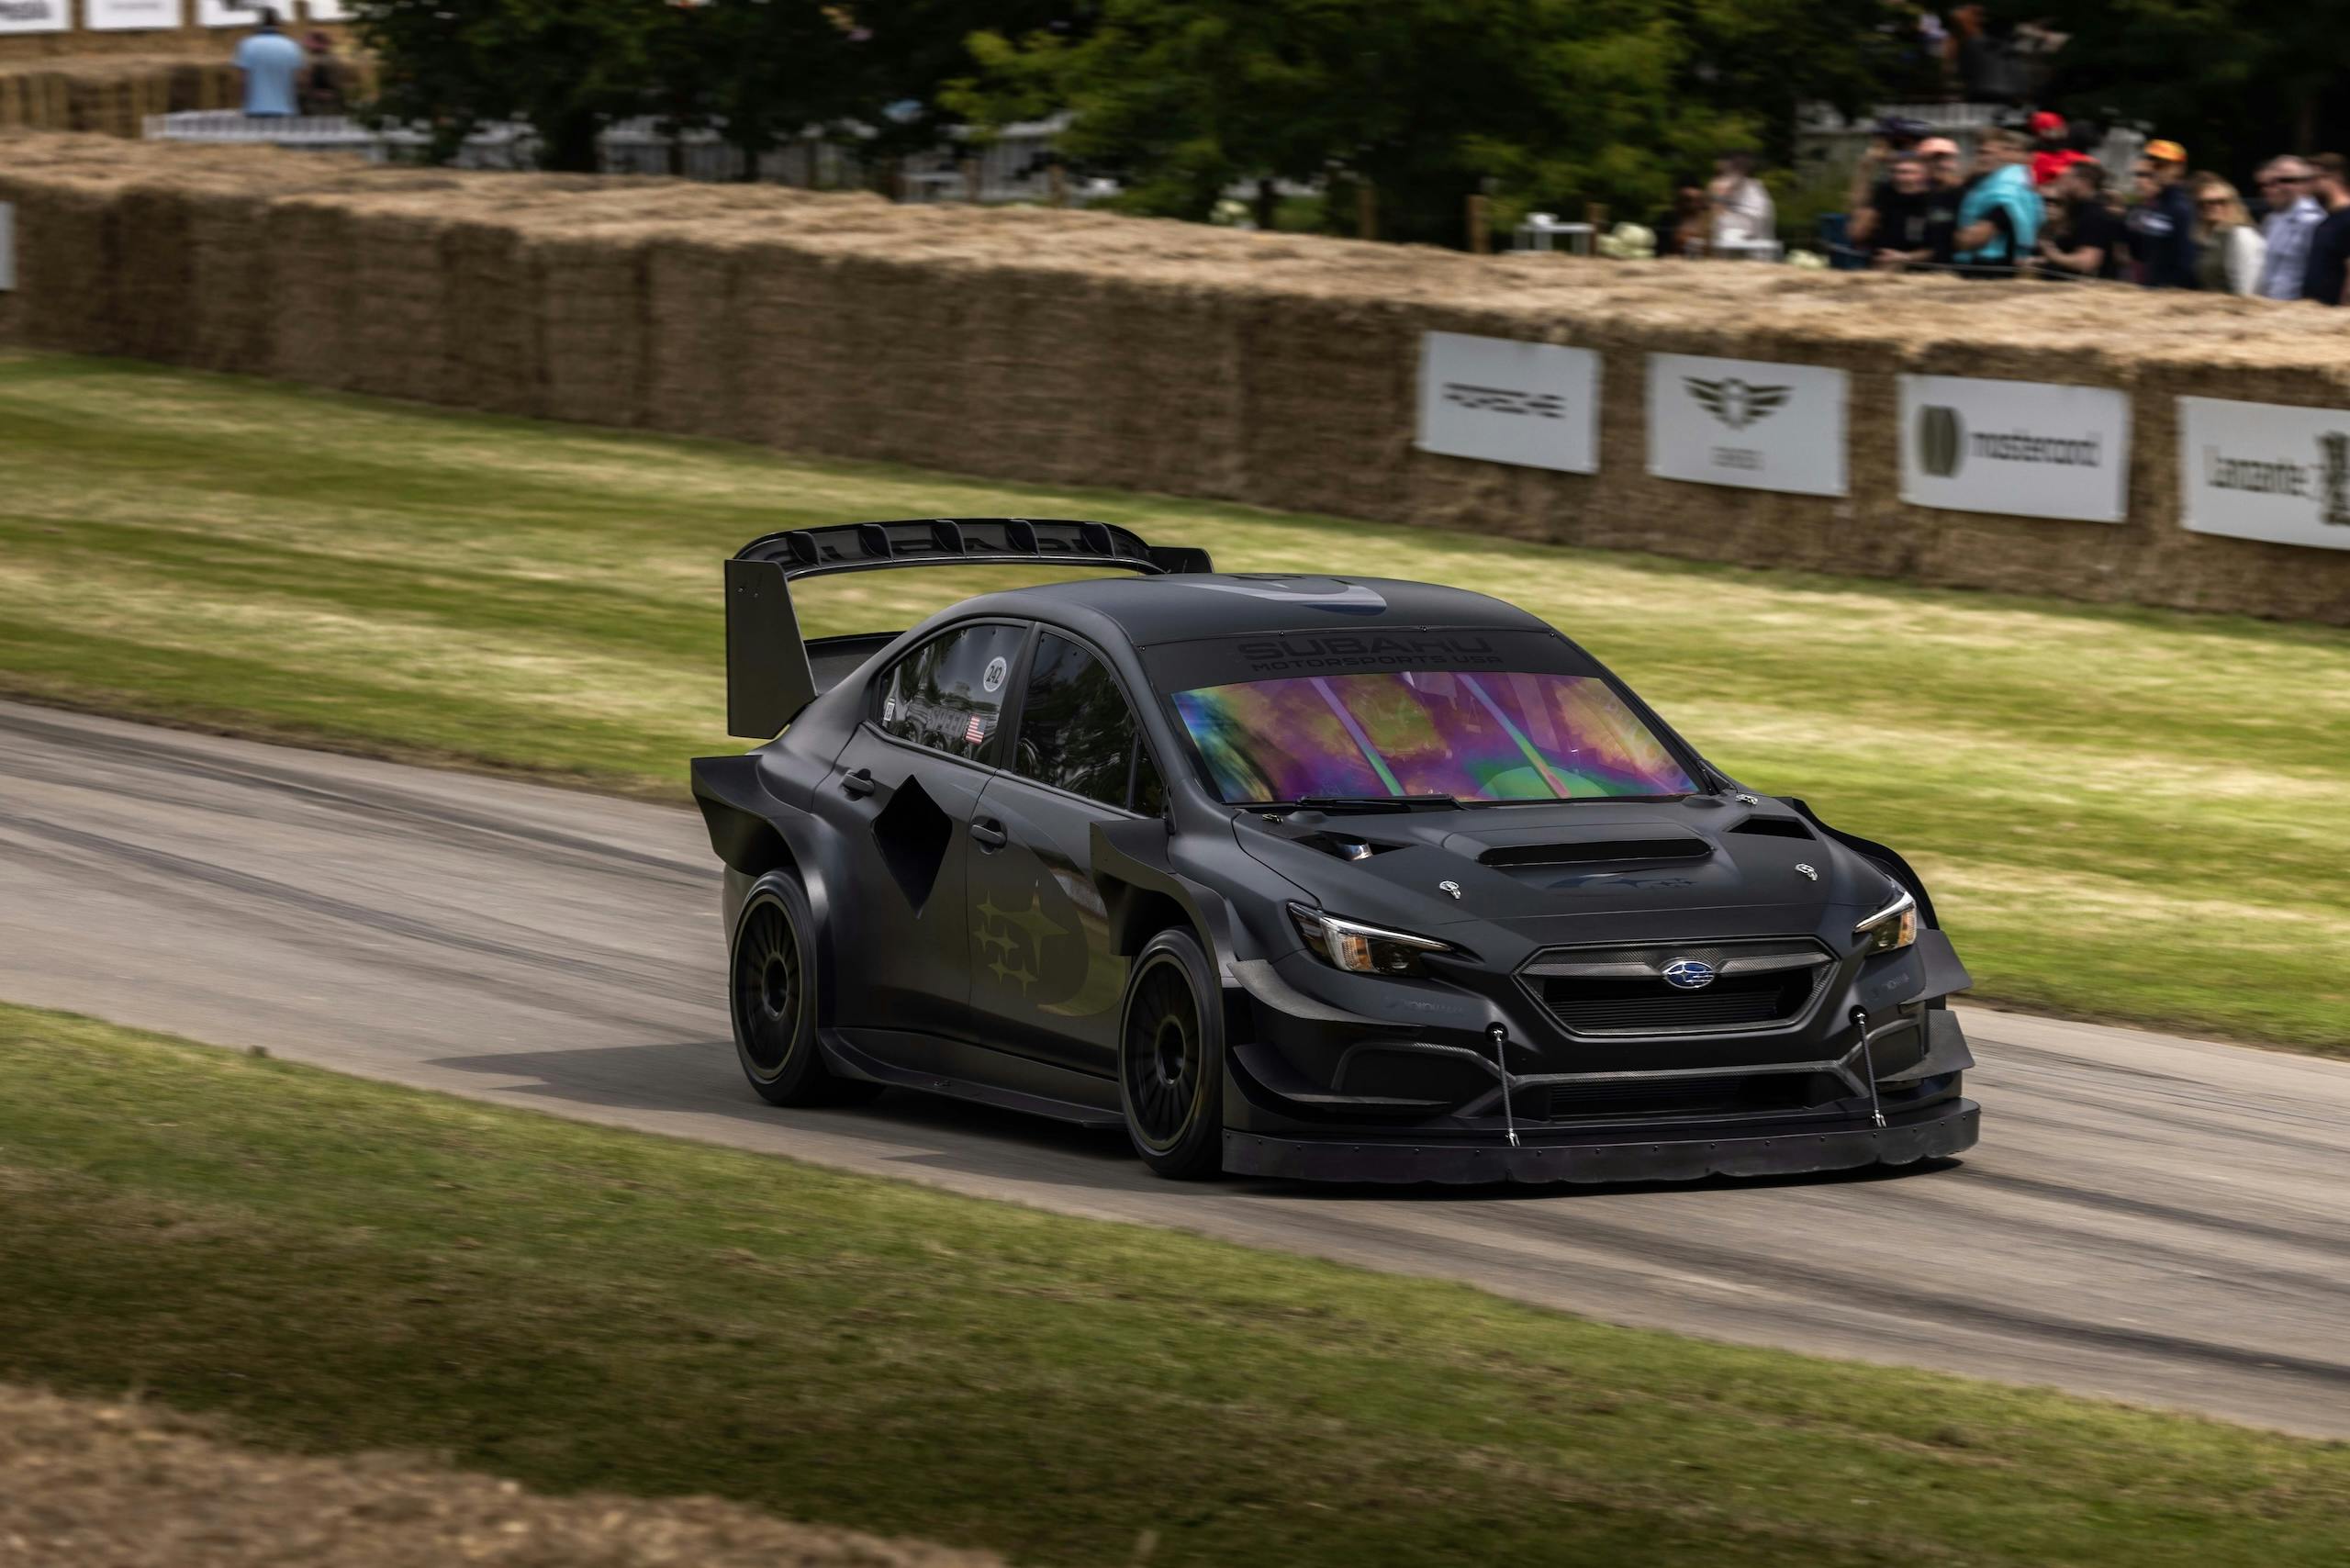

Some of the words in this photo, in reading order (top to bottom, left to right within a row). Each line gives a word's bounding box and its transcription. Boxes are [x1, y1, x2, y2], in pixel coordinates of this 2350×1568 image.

[1443, 382, 1565, 419] PORSCHE
[1969, 429, 2103, 467] mastercard
[1237, 637, 1493, 660] SUBARU
[986, 666, 1002, 684] 242
[1251, 655, 1448, 673] MOTORSPORTS
[1453, 655, 1505, 665] USA
